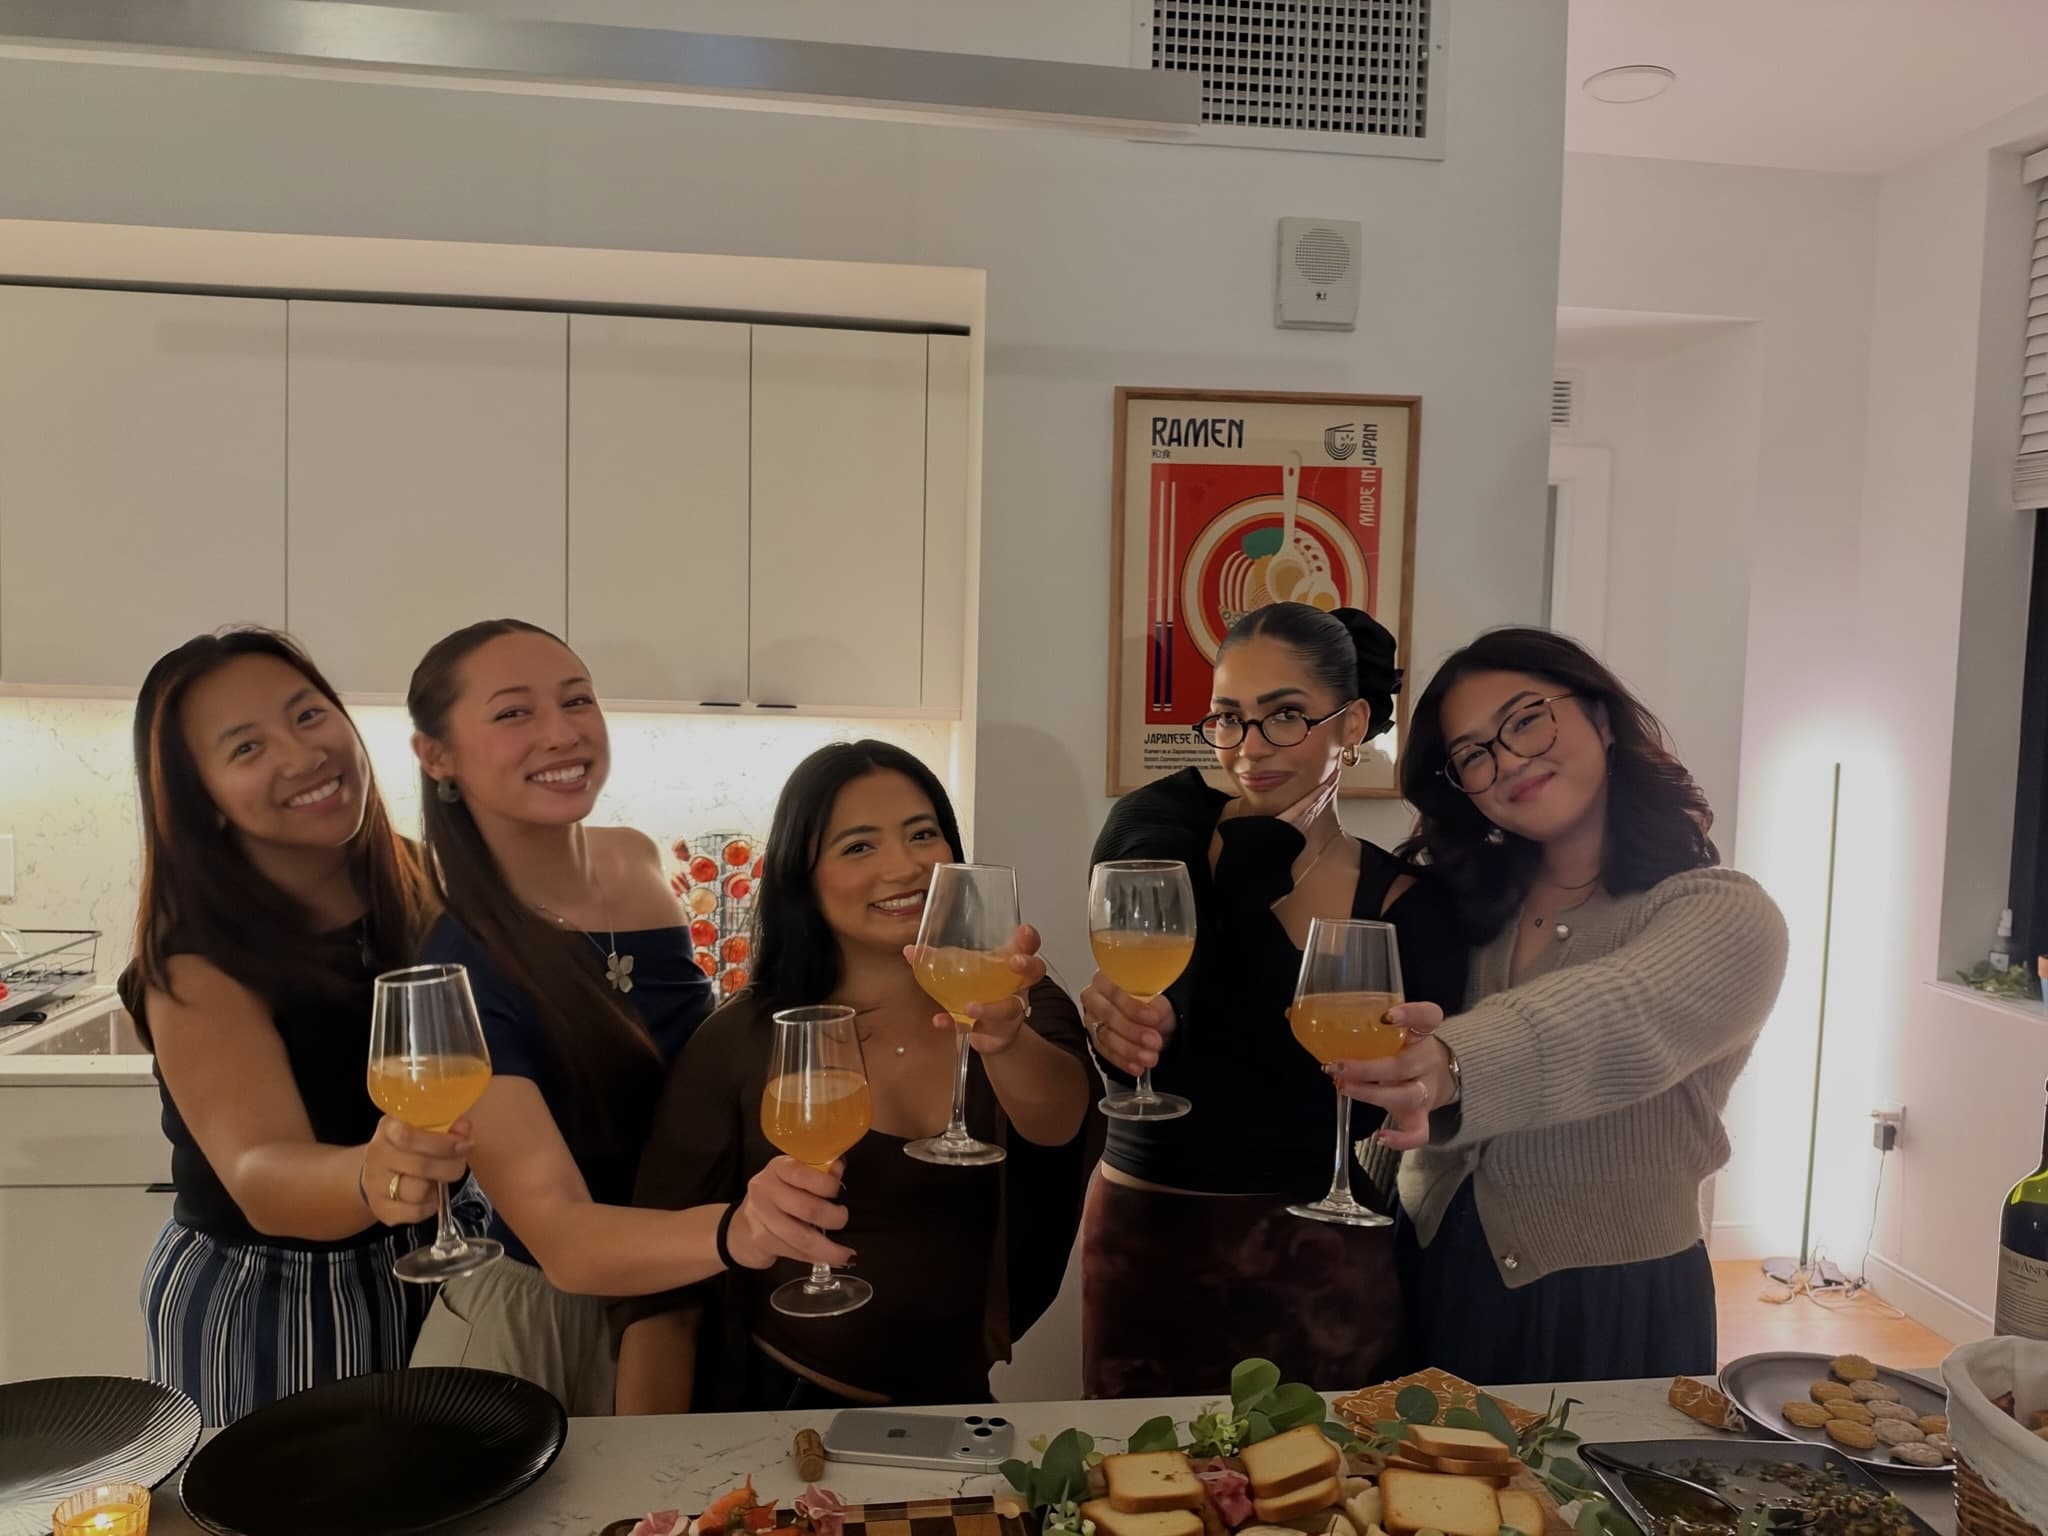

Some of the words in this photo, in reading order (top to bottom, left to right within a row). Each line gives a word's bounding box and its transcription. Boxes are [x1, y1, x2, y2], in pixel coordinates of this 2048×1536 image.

[1151, 417, 1245, 448] RAMEN
[1361, 423, 1378, 466] JAPAN
[1361, 470, 1377, 483] IN
[1359, 487, 1376, 526] MADE
[1144, 734, 1192, 744] JAPANESE
